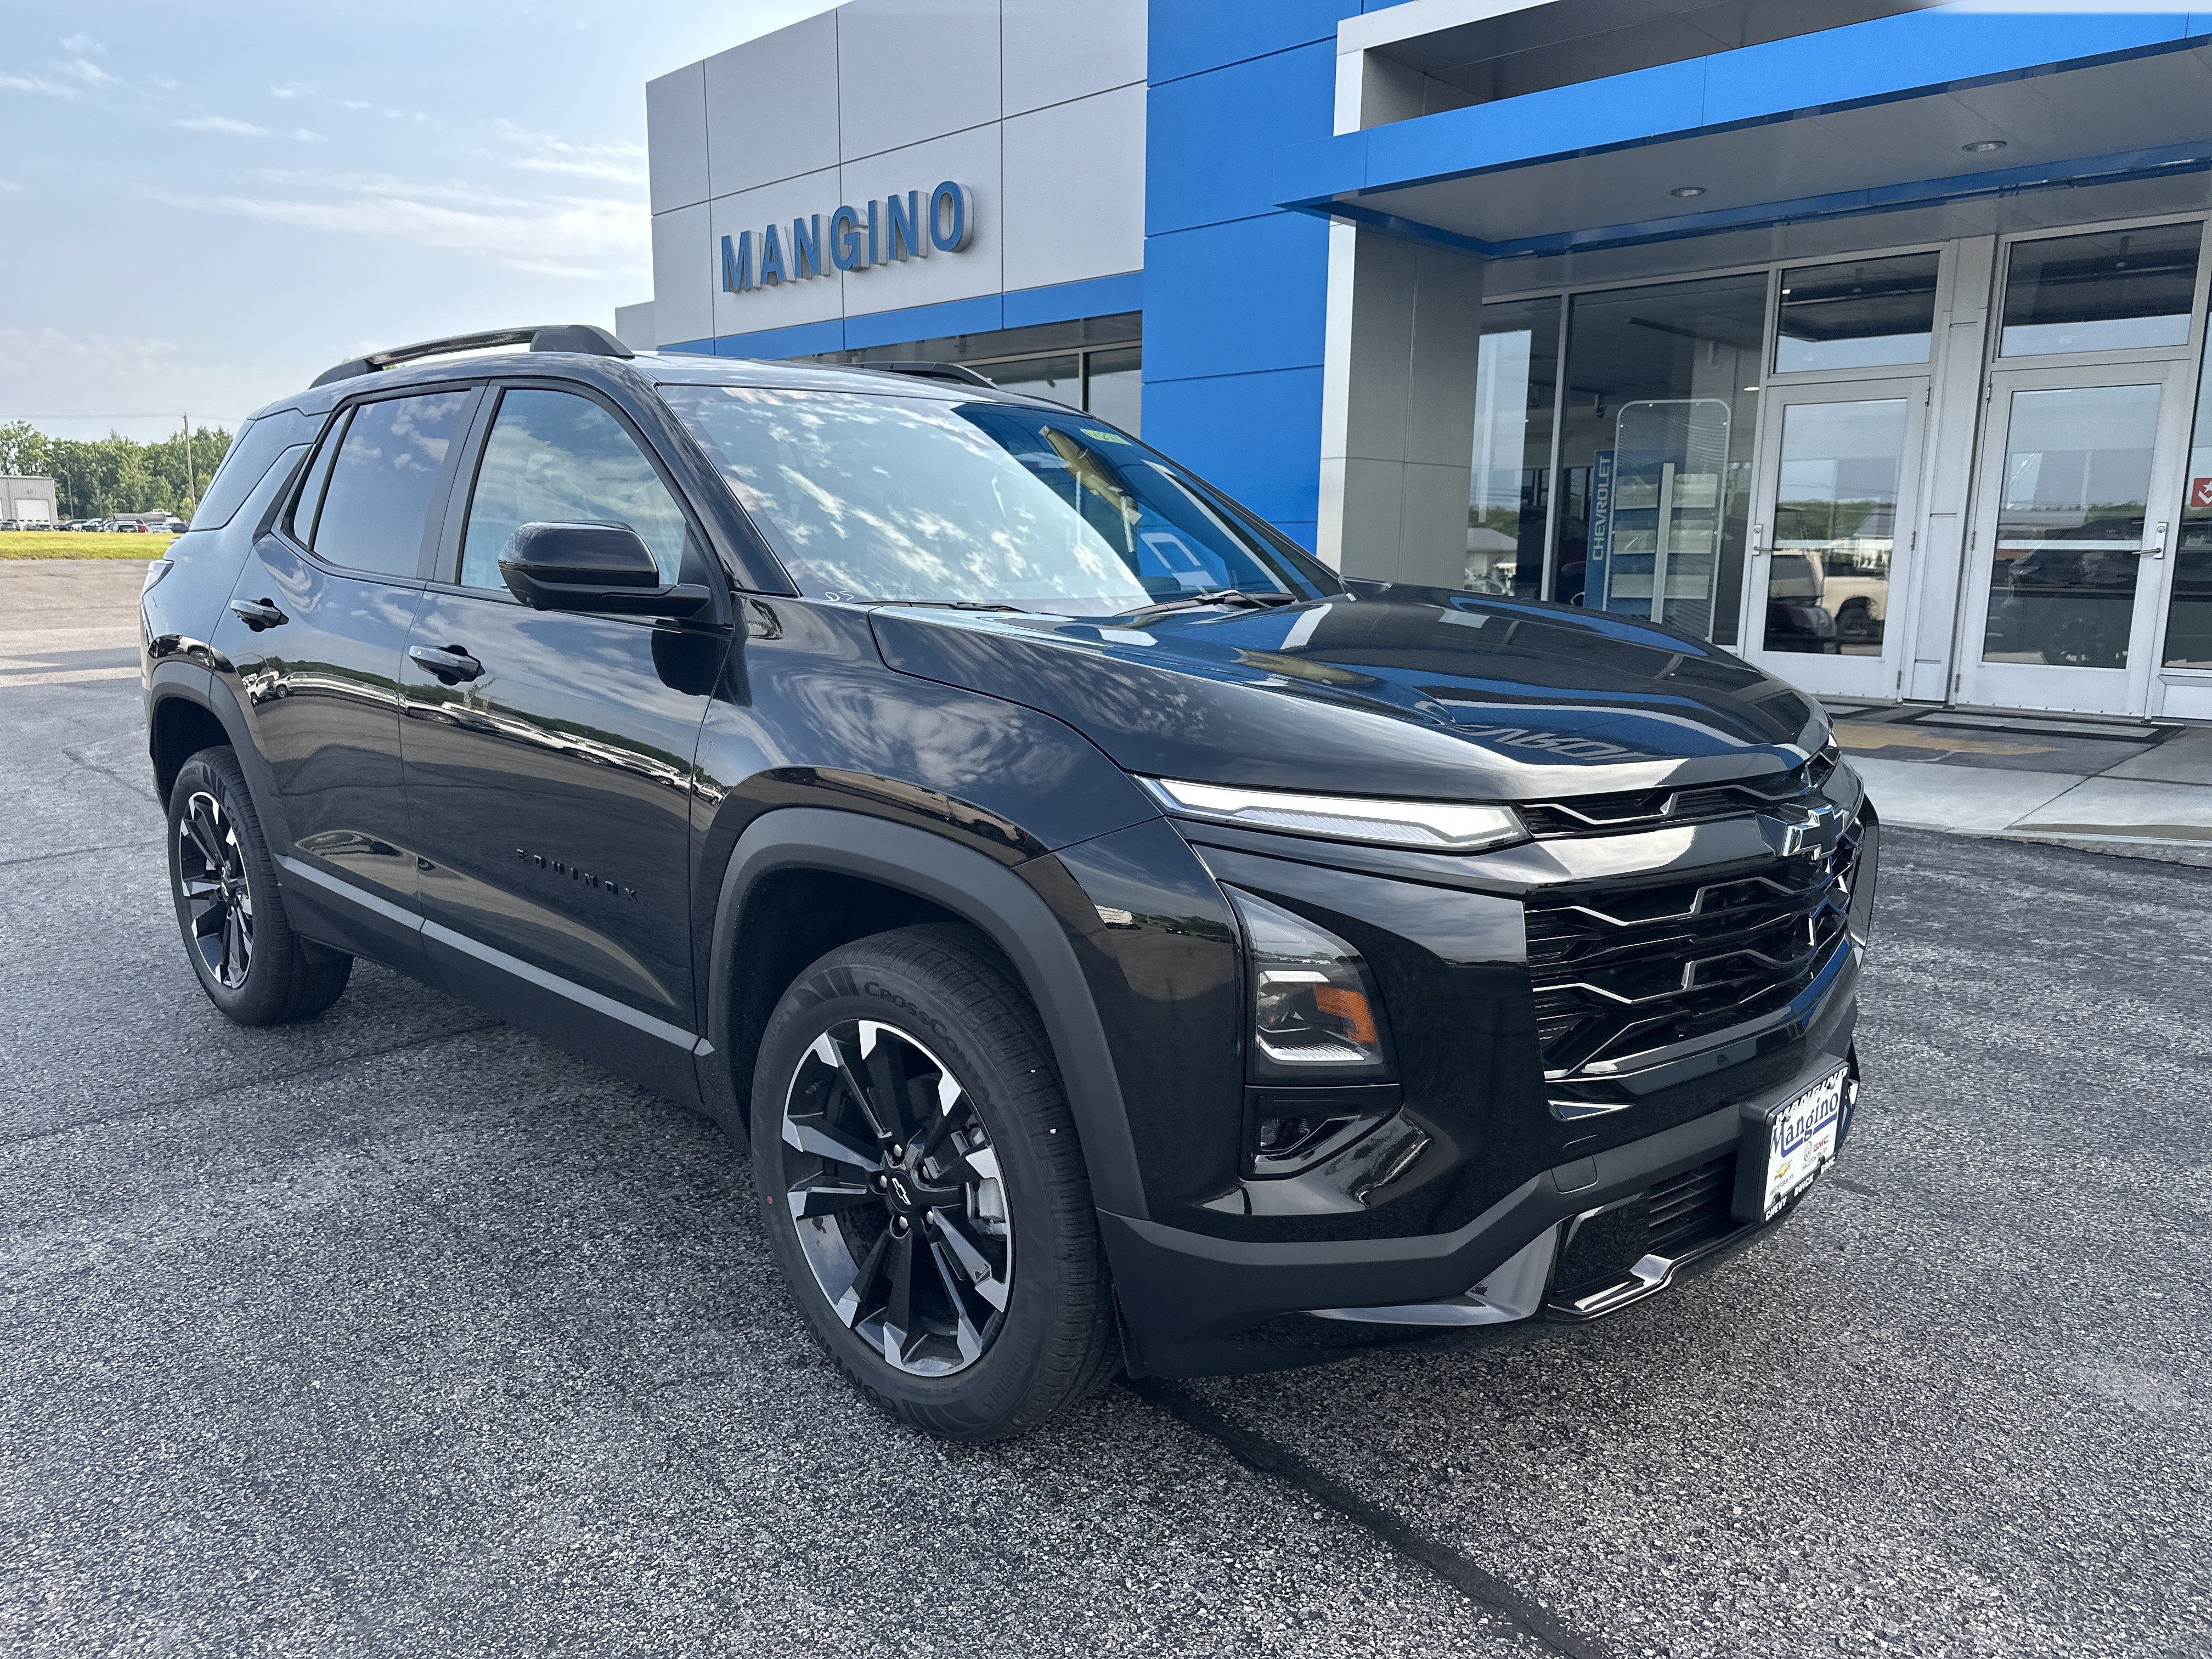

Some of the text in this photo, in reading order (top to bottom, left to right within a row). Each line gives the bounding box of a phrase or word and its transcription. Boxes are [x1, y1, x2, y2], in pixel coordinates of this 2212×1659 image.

[721, 180, 971, 294] MANGINO
[1593, 456, 1611, 561] CHEVROLET
[517, 848, 639, 904] EQUINOX
[1771, 1092, 1838, 1158] Mangino
[1813, 1135, 1829, 1153] GMC
[1765, 1156, 1836, 1221] CHEVY BUICK GMC
